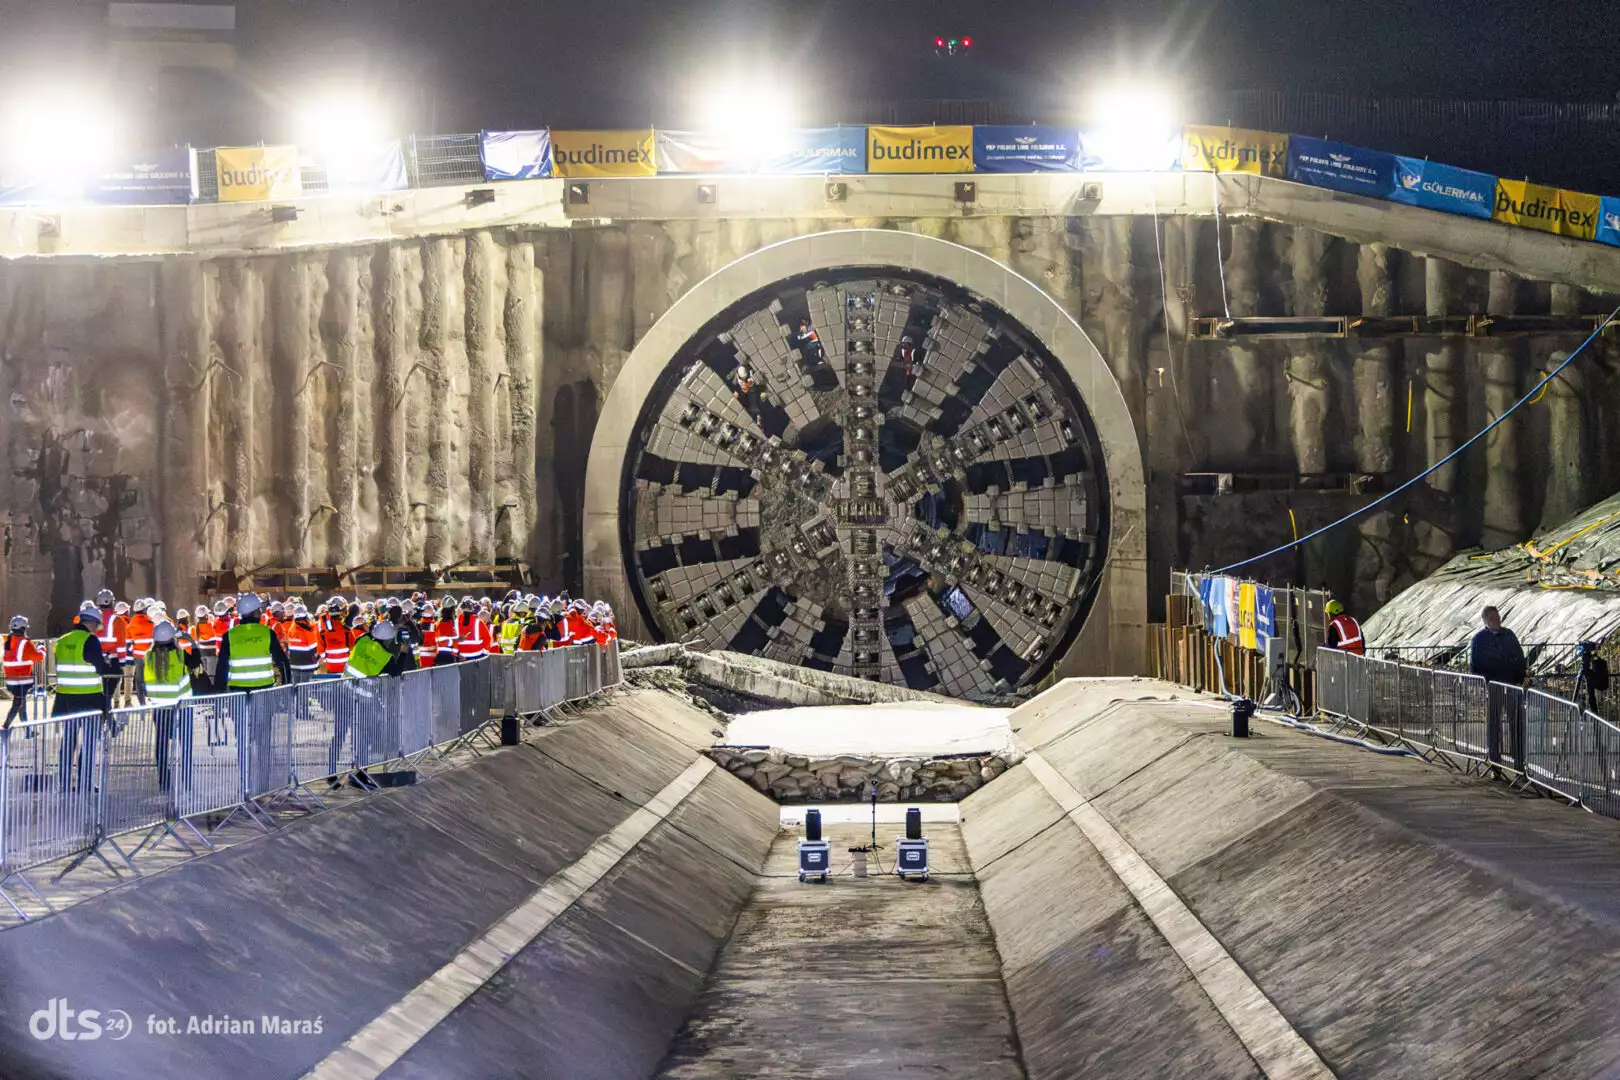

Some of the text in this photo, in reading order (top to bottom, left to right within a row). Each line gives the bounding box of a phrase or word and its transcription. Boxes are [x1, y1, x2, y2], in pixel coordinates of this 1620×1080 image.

[554, 143, 652, 165] budimex
[873, 139, 970, 160] budimex
[1422, 181, 1485, 202] GÜLERMAK
[1496, 191, 1593, 227] budimex
